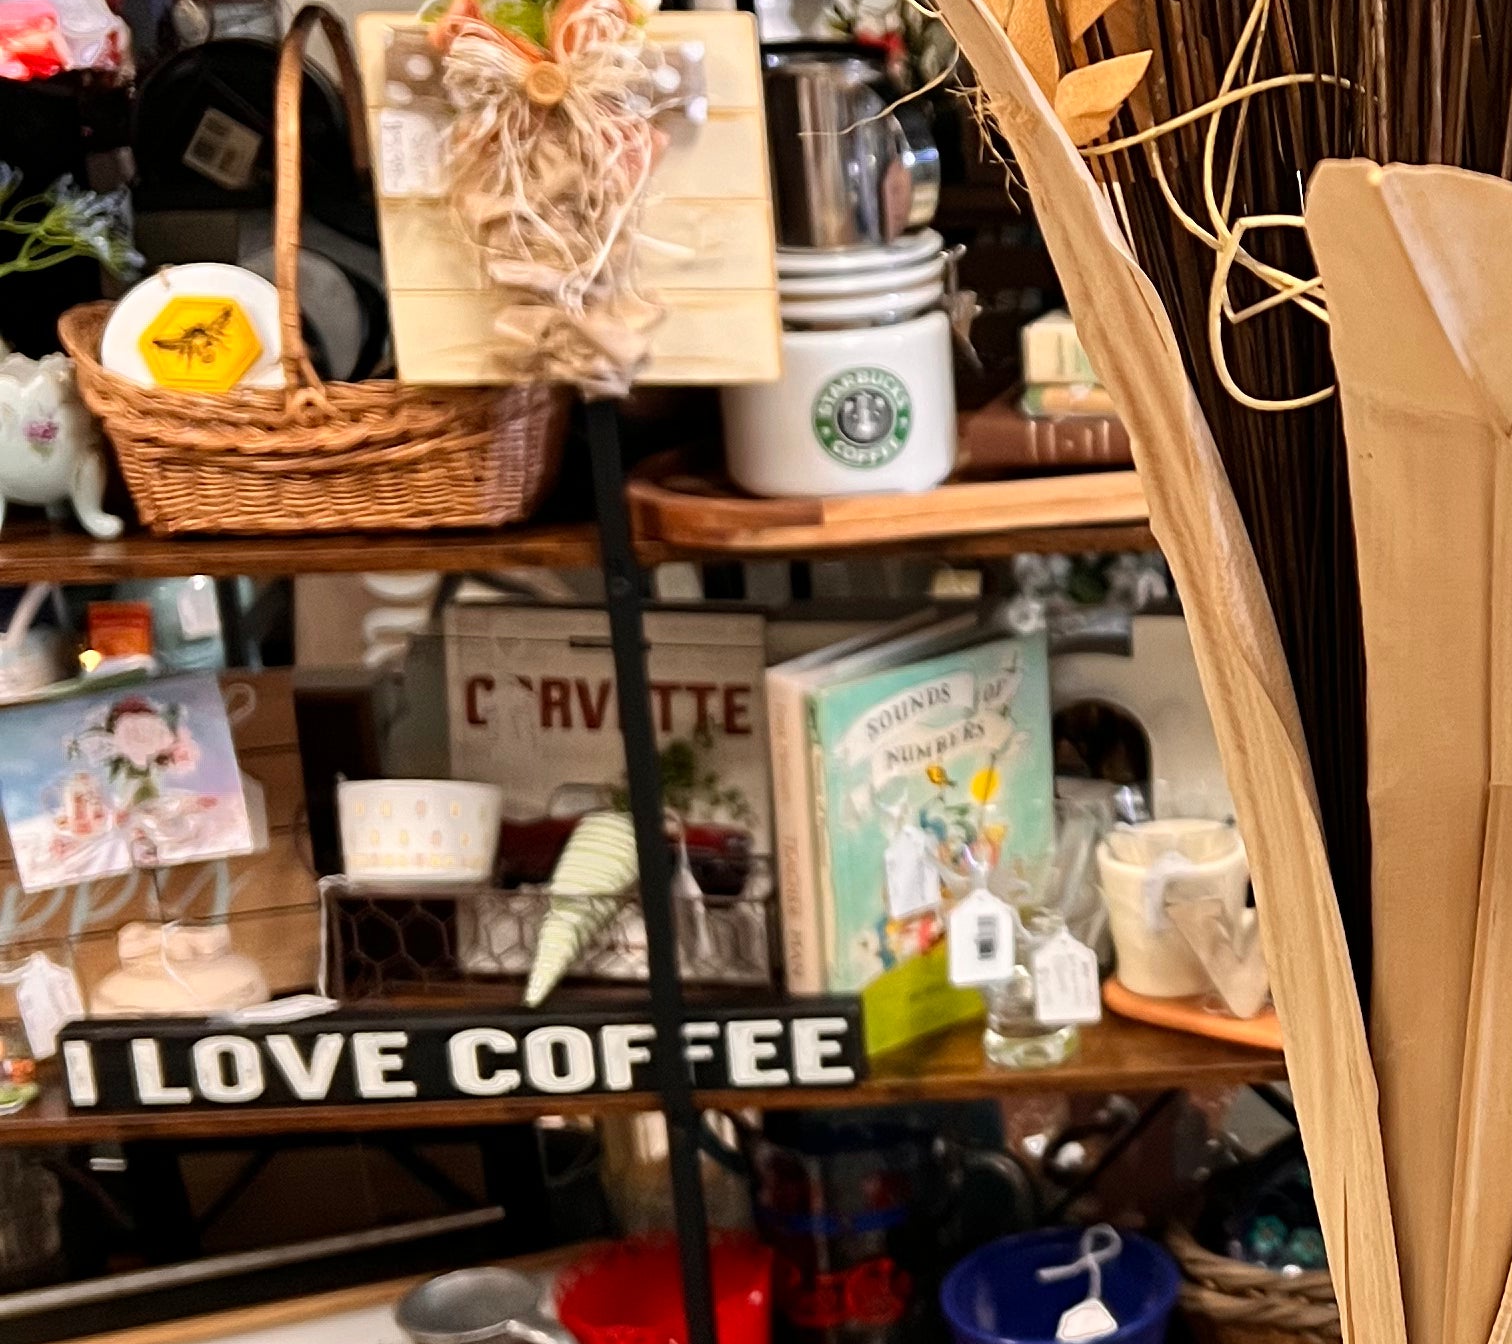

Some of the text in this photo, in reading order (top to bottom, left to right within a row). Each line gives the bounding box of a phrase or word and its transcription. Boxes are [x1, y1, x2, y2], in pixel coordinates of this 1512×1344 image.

[463, 673, 752, 736] CRVTTE
[865, 679, 952, 744] SOUNDS
[882, 718, 986, 772] NUMBERS
[63, 1017, 856, 1107] I LOVE COFFEE
